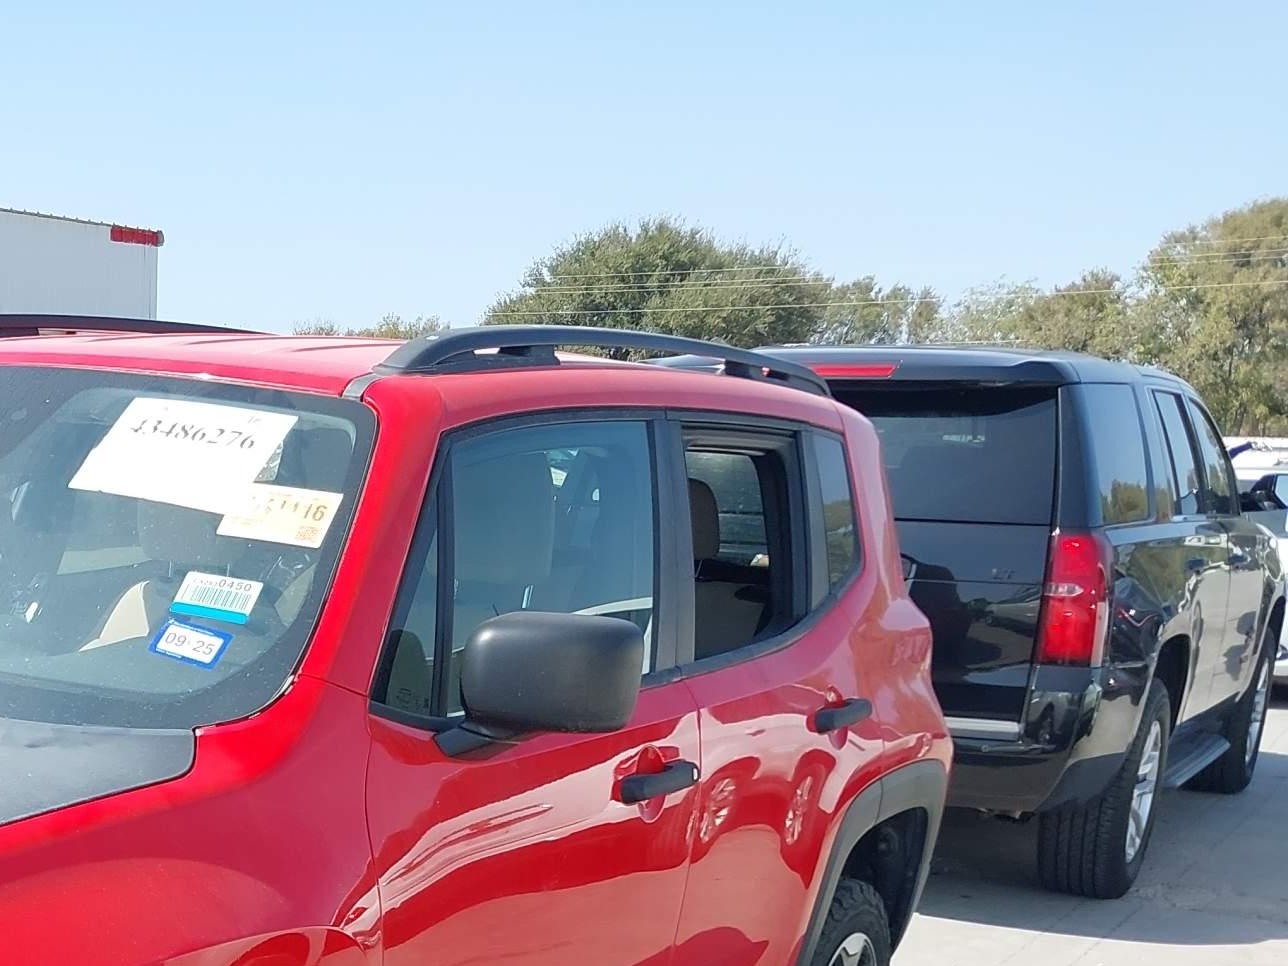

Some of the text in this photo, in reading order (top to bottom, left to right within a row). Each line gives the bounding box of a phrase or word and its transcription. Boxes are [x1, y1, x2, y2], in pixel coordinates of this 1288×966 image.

[131, 418, 255, 450] 43486276
[164, 632, 187, 647] 09
[192, 640, 215, 656] 25
